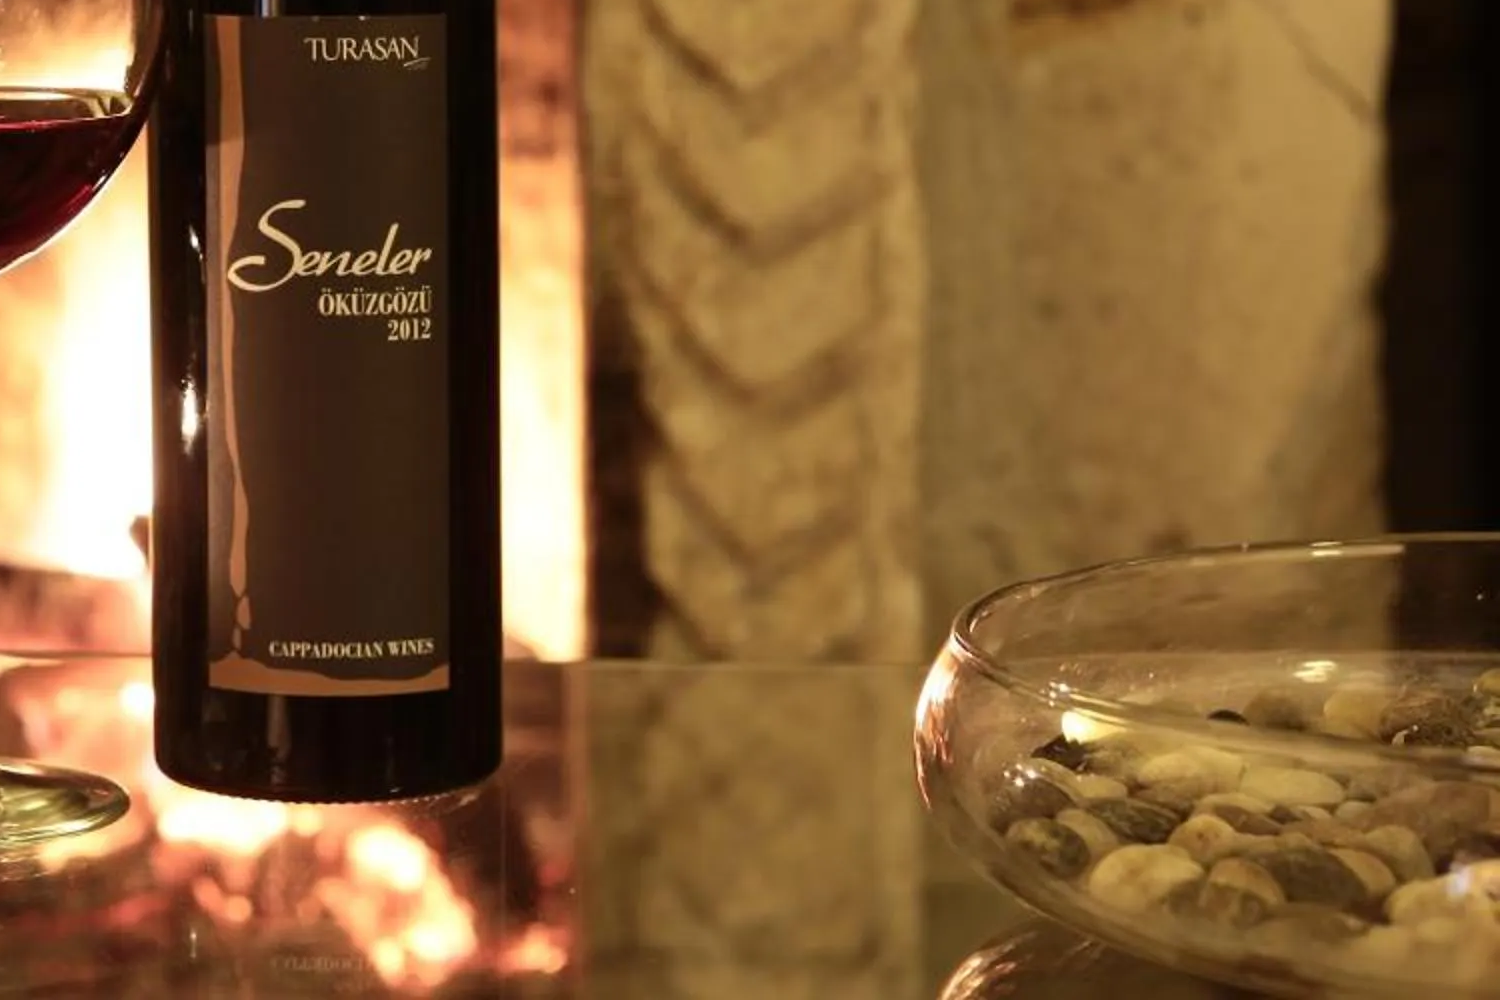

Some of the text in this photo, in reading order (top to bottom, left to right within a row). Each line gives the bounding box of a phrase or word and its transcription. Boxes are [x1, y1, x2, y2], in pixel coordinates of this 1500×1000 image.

[304, 36, 419, 62] TURASAN
[227, 199, 432, 293] Seneler
[319, 286, 432, 316] ÖKÜZGÖZÜ
[387, 318, 431, 341] 2012
[268, 637, 434, 658] CAPPADOCIAN WINES
